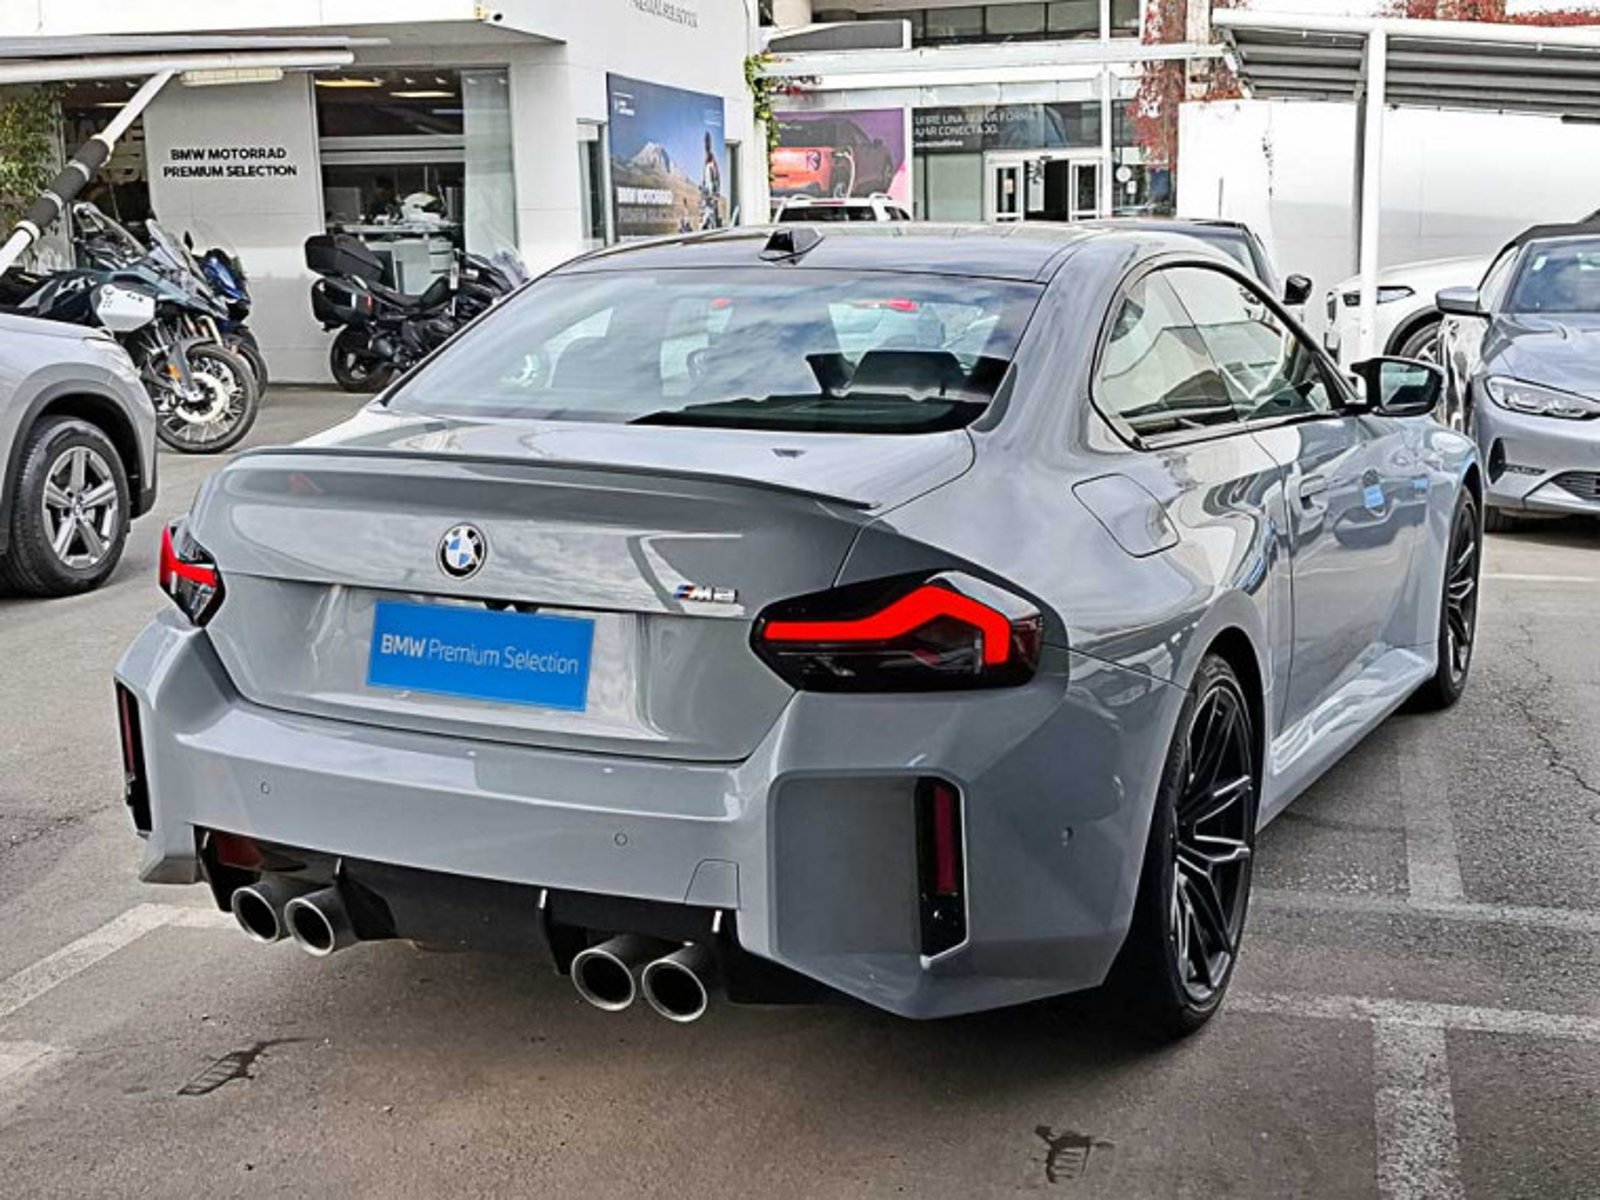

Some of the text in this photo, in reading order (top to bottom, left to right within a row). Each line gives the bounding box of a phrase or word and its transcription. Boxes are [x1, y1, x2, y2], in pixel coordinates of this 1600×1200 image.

[170, 147, 287, 160] BMW MOTORRAD
[163, 165, 298, 177] PREMIUM SELECTION
[379, 632, 579, 675] BMW Premium Selection
